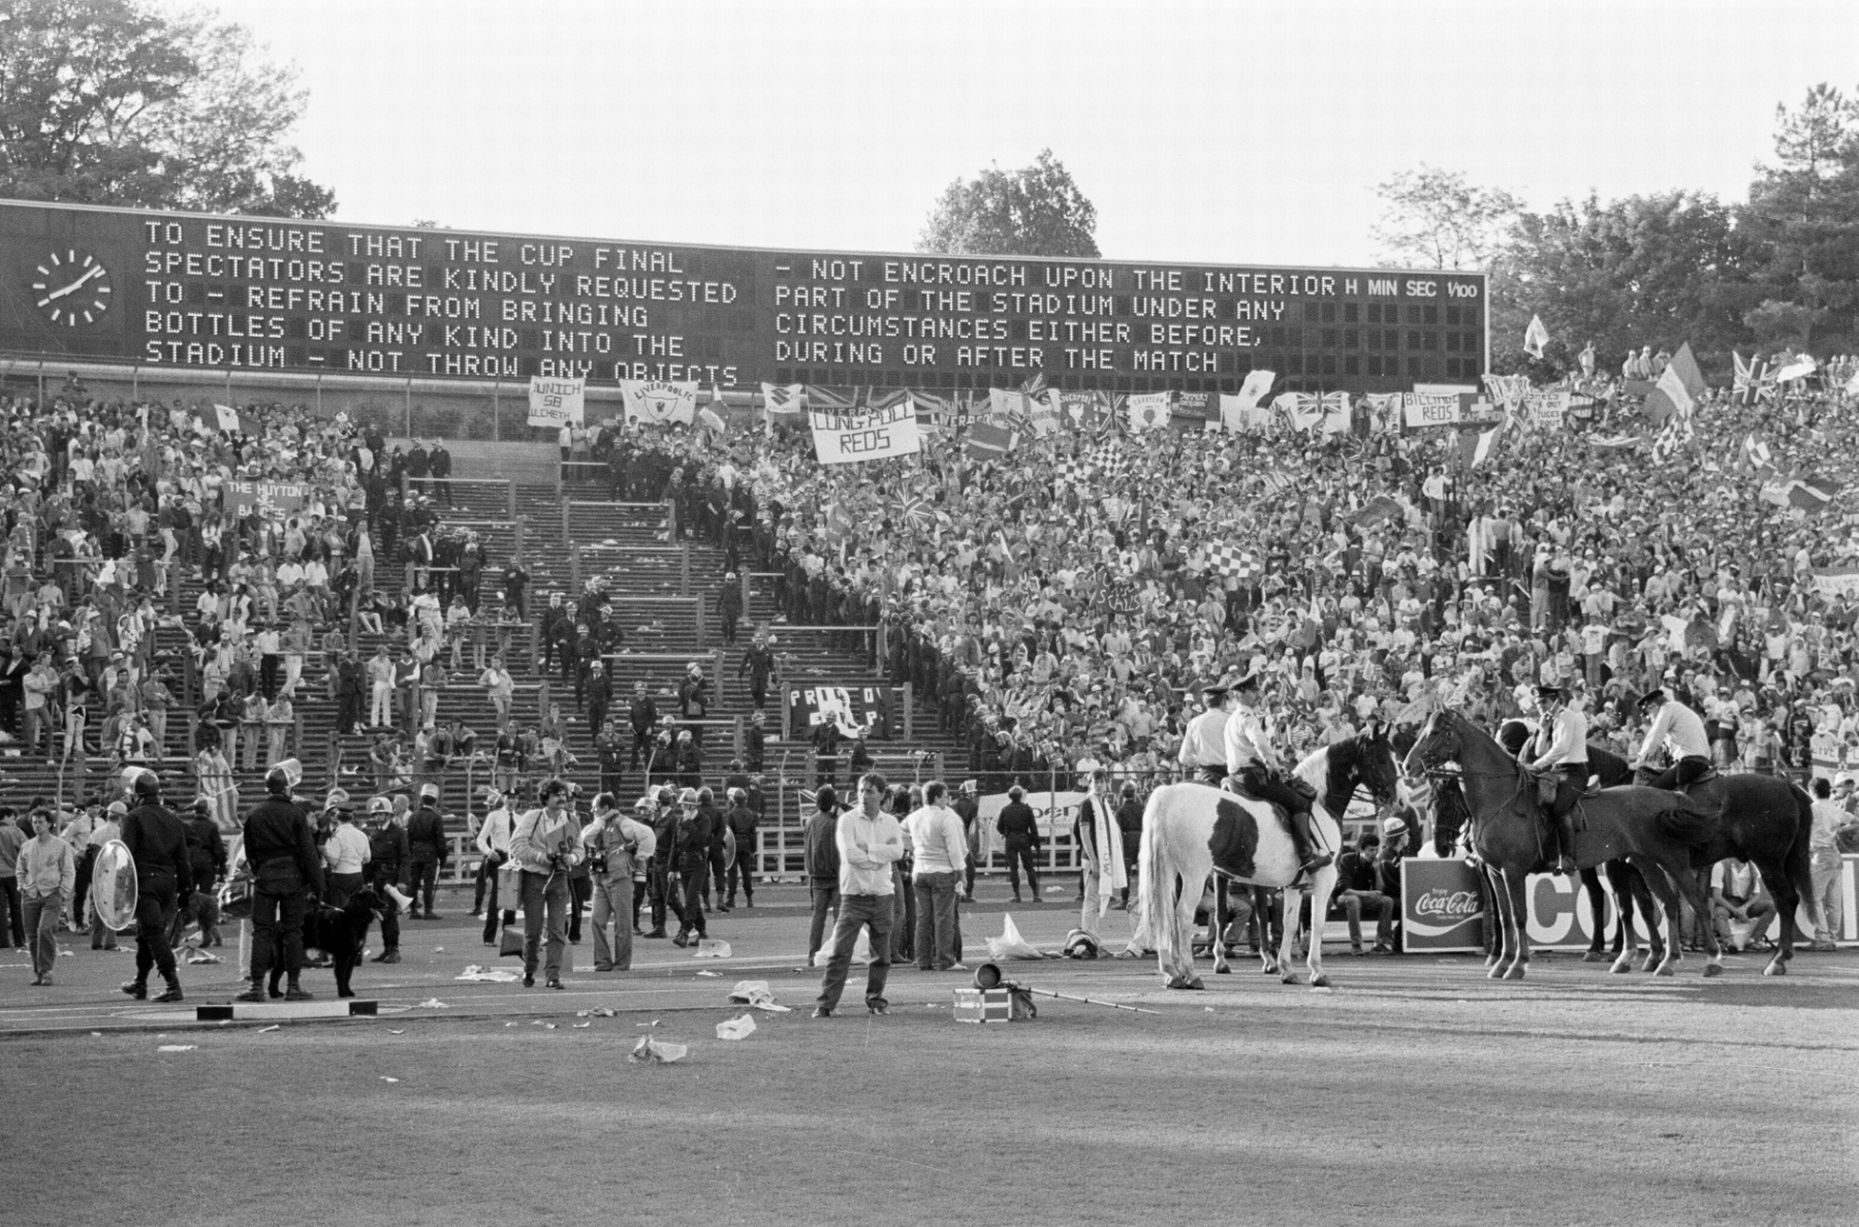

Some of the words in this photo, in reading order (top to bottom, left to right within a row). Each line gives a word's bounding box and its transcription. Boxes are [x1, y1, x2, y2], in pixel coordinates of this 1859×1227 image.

[145, 221, 183, 245] TO
[207, 225, 324, 254] ENSURE
[348, 234, 422, 259] THAT
[445, 240, 499, 263] THE
[522, 245, 574, 267] CUP
[596, 249, 683, 274] FINAL
[145, 251, 344, 284] SPECTATORS
[368, 264, 422, 288] ARE
[445, 268, 555, 296] KINDLY
[578, 275, 737, 304] REQUESTED
[813, 260, 863, 281] NOT
[885, 262, 1025, 287] ENCROACH
[1047, 267, 1113, 289] UPON
[1134, 270, 1182, 291] THE
[1205, 273, 1336, 296] INTERIOR
[1345, 279, 1358, 295] H
[1368, 280, 1398, 296] MIN
[1406, 281, 1437, 297] SEC
[146, 280, 183, 304] TO
[248, 286, 384, 315] REFRAIN
[407, 295, 480, 319] FROM
[503, 300, 648, 328] BRINGING
[776, 286, 846, 308] PART
[868, 289, 900, 310] OF
[921, 290, 972, 312] THE
[993, 293, 1113, 316] STADIUM
[1134, 297, 1217, 319] UNDER
[1237, 300, 1285, 321] ANY
[146, 310, 285, 339] BOTTLES
[309, 319, 345, 341] OF
[368, 321, 423, 345] ANY
[446, 325, 518, 350] KIND
[543, 330, 611, 354] INTO
[633, 334, 684, 357] THE
[776, 313, 1008, 340] CIRCUMSTANCES
[1029, 320, 1131, 344] EITHER
[1151, 324, 1261, 347] BEFORE,
[146, 340, 285, 368] STADIUM
[349, 349, 404, 373] NOT
[426, 353, 518, 378] THROW
[541, 359, 592, 380] ANY
[614, 361, 738, 387] OBJECTS
[777, 341, 882, 364] DURING
[904, 344, 936, 366] OR
[958, 346, 1044, 368] AFTER
[1065, 348, 1113, 370] THE
[1134, 350, 1217, 373] MATCH
[634, 382, 682, 400] LIVERPOOL
[683, 391, 693, 402] FC
[1423, 405, 1453, 420] REDS
[840, 427, 891, 454] REDS
[227, 481, 252, 493] THE
[257, 483, 303, 498] HUYTON
[1415, 890, 1478, 916] Coca-Cola
